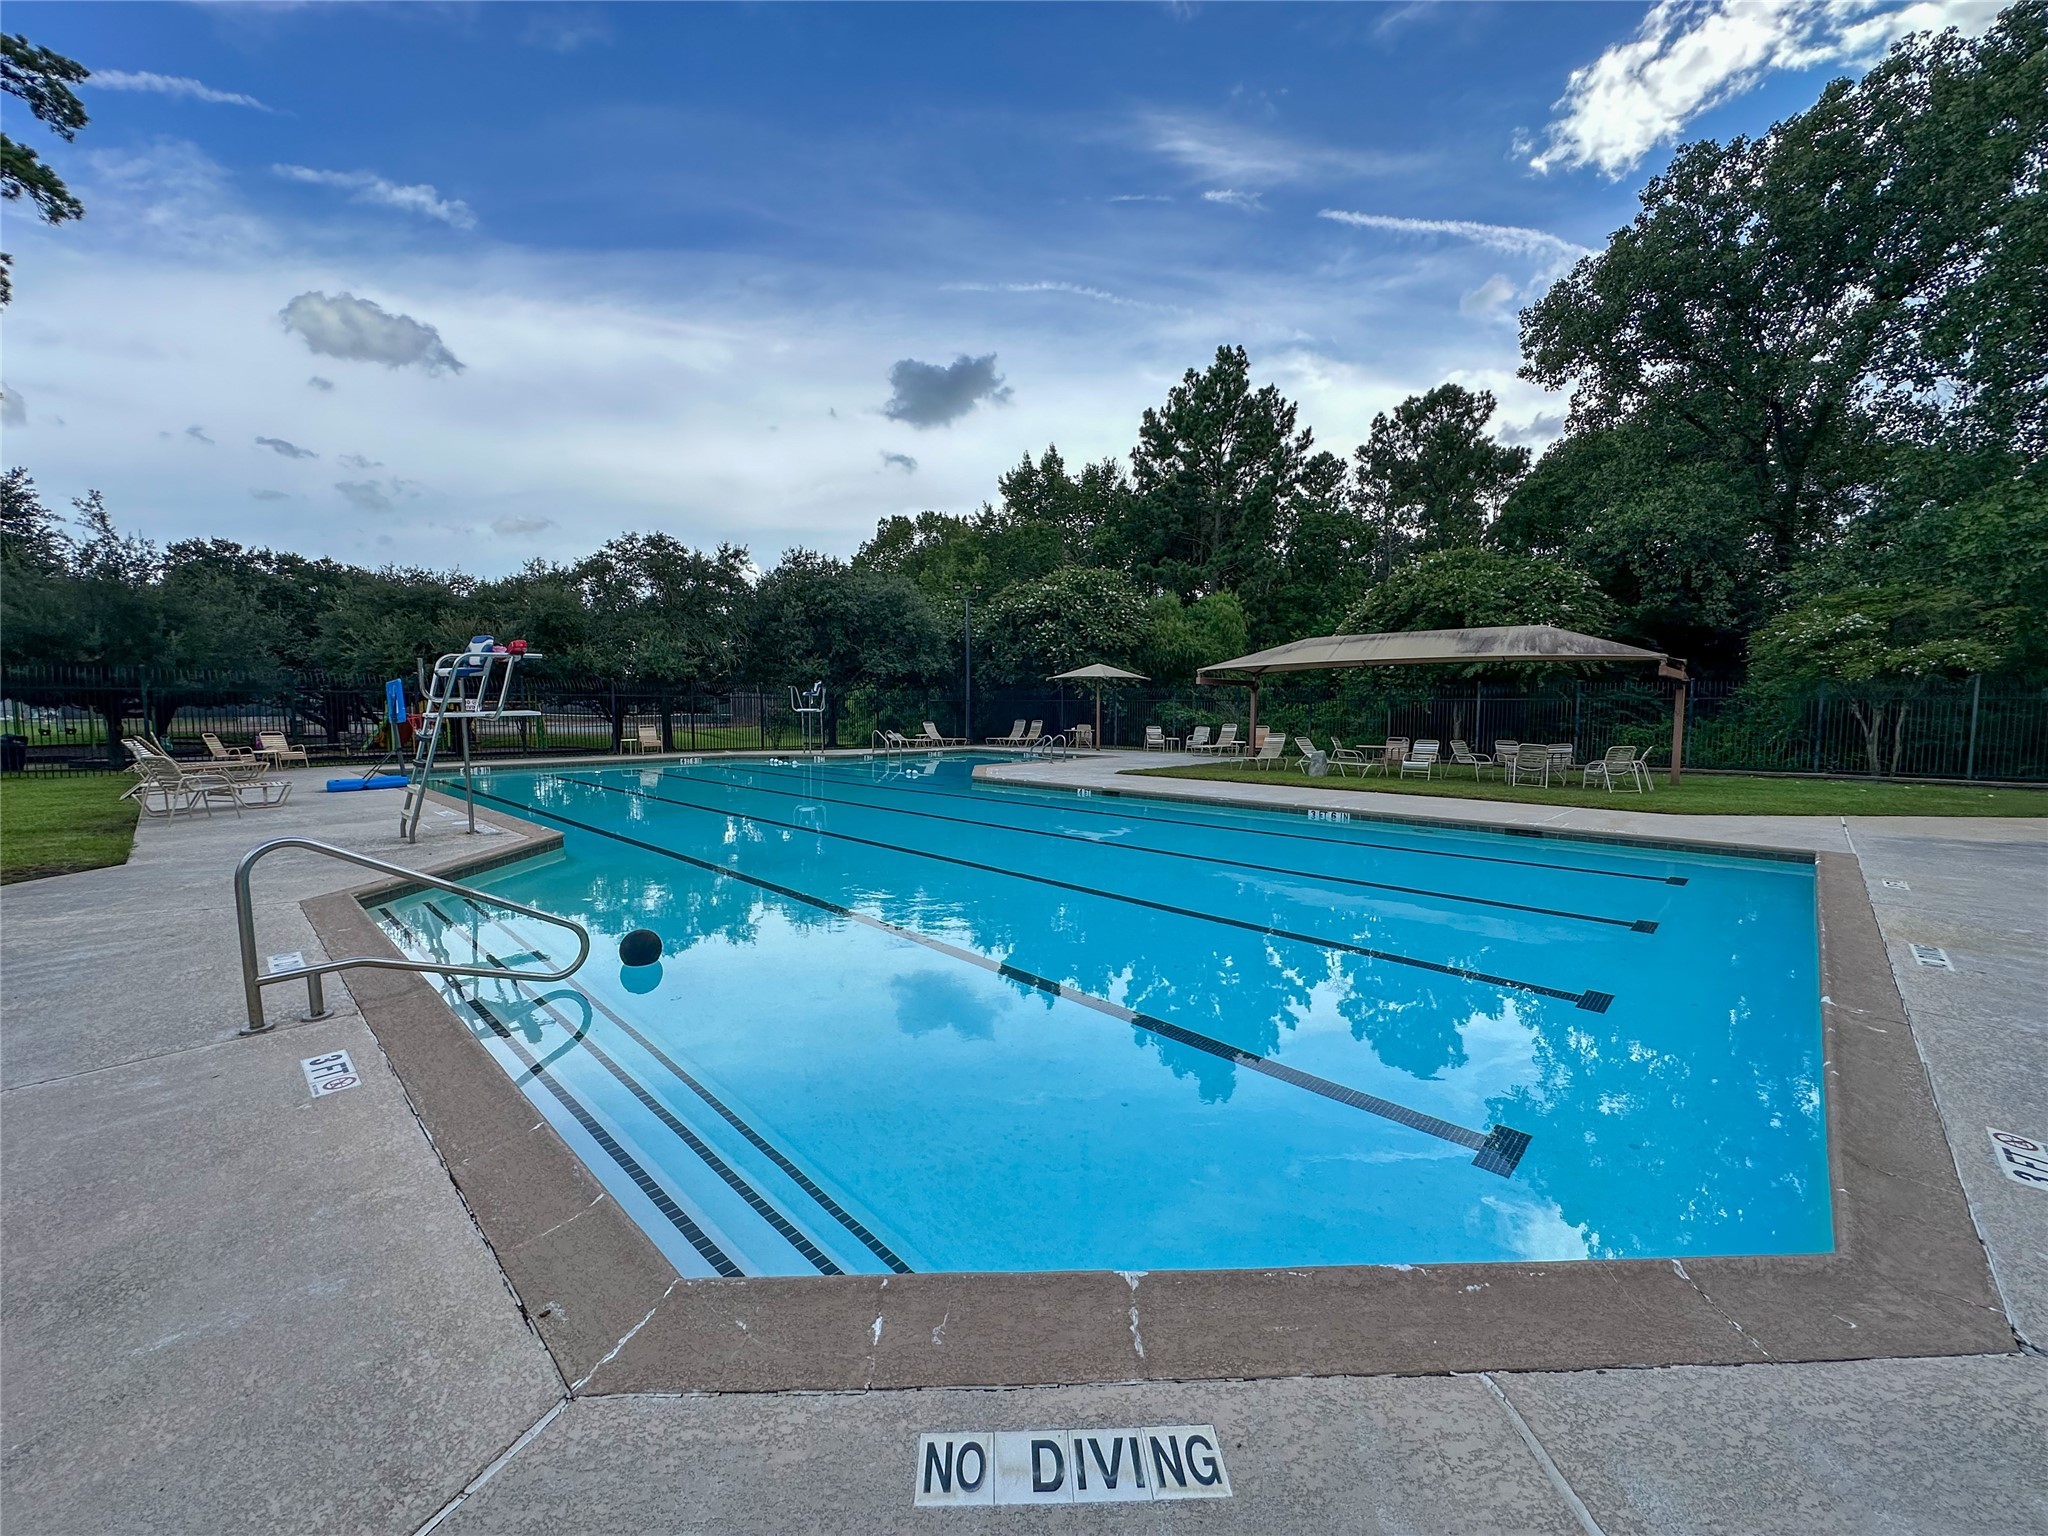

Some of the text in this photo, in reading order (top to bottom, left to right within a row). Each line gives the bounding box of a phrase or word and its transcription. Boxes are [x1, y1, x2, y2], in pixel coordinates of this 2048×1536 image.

[1341, 812, 1349, 823] IN
[309, 1054, 349, 1080] 3 FT
[2002, 1147, 2048, 1187] 3 FT
[923, 1434, 1223, 1493] NO DIVING
